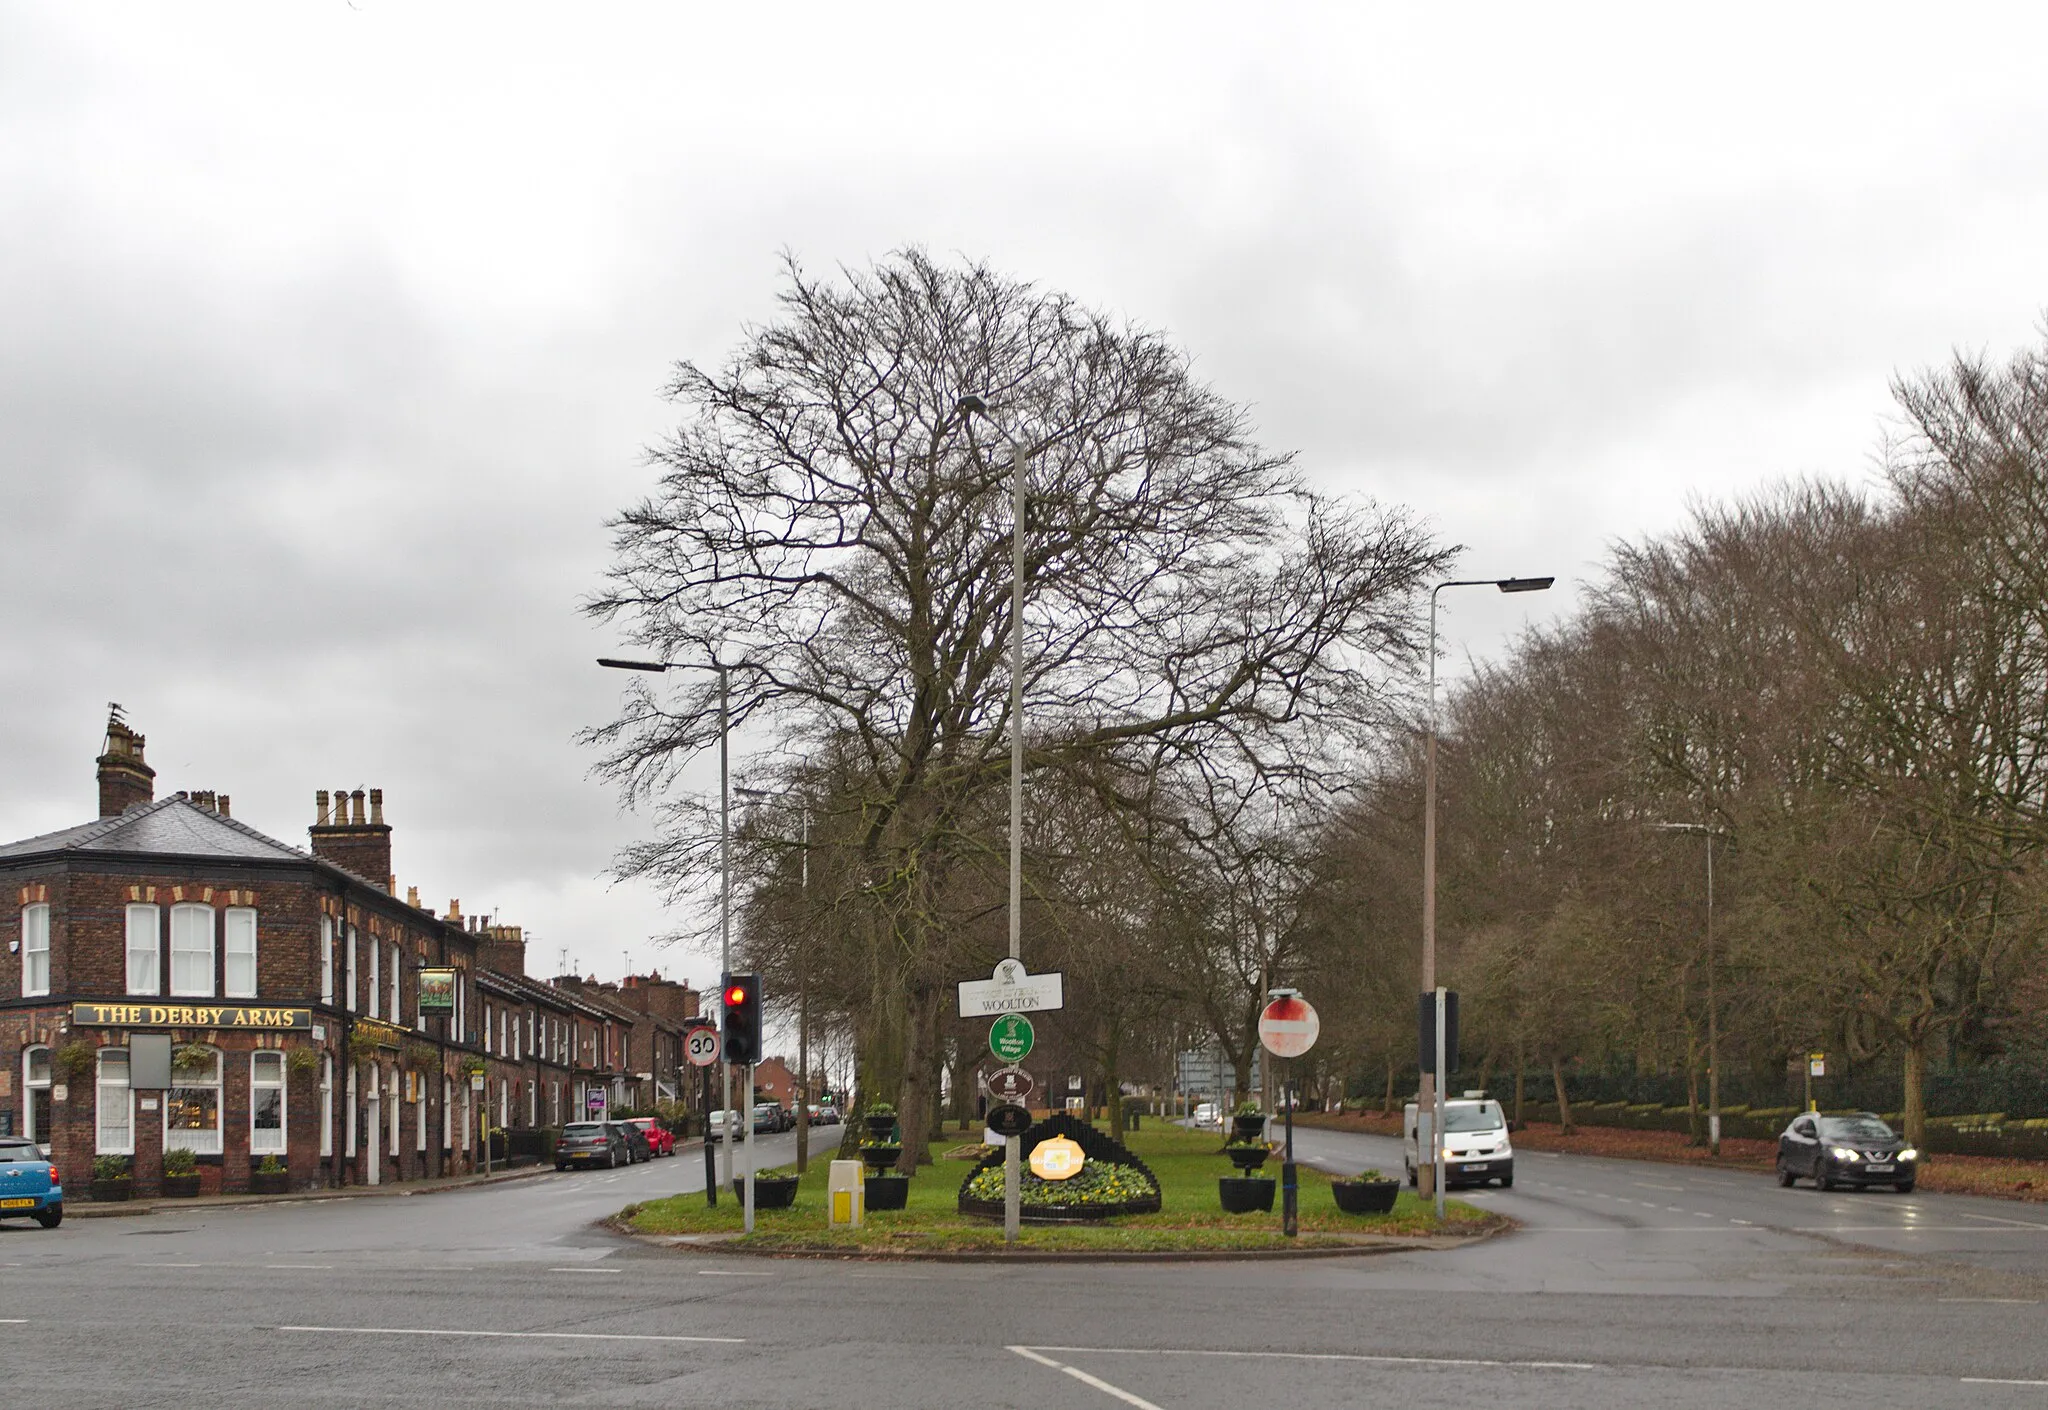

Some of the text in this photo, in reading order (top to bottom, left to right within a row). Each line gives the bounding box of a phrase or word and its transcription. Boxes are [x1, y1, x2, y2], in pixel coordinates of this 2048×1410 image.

[982, 996, 1040, 1012] WOOLTON
[94, 1006, 295, 1027] THE DERBY ARMS
[690, 1037, 715, 1054] 30
[1001, 1045, 1022, 1054] Village
